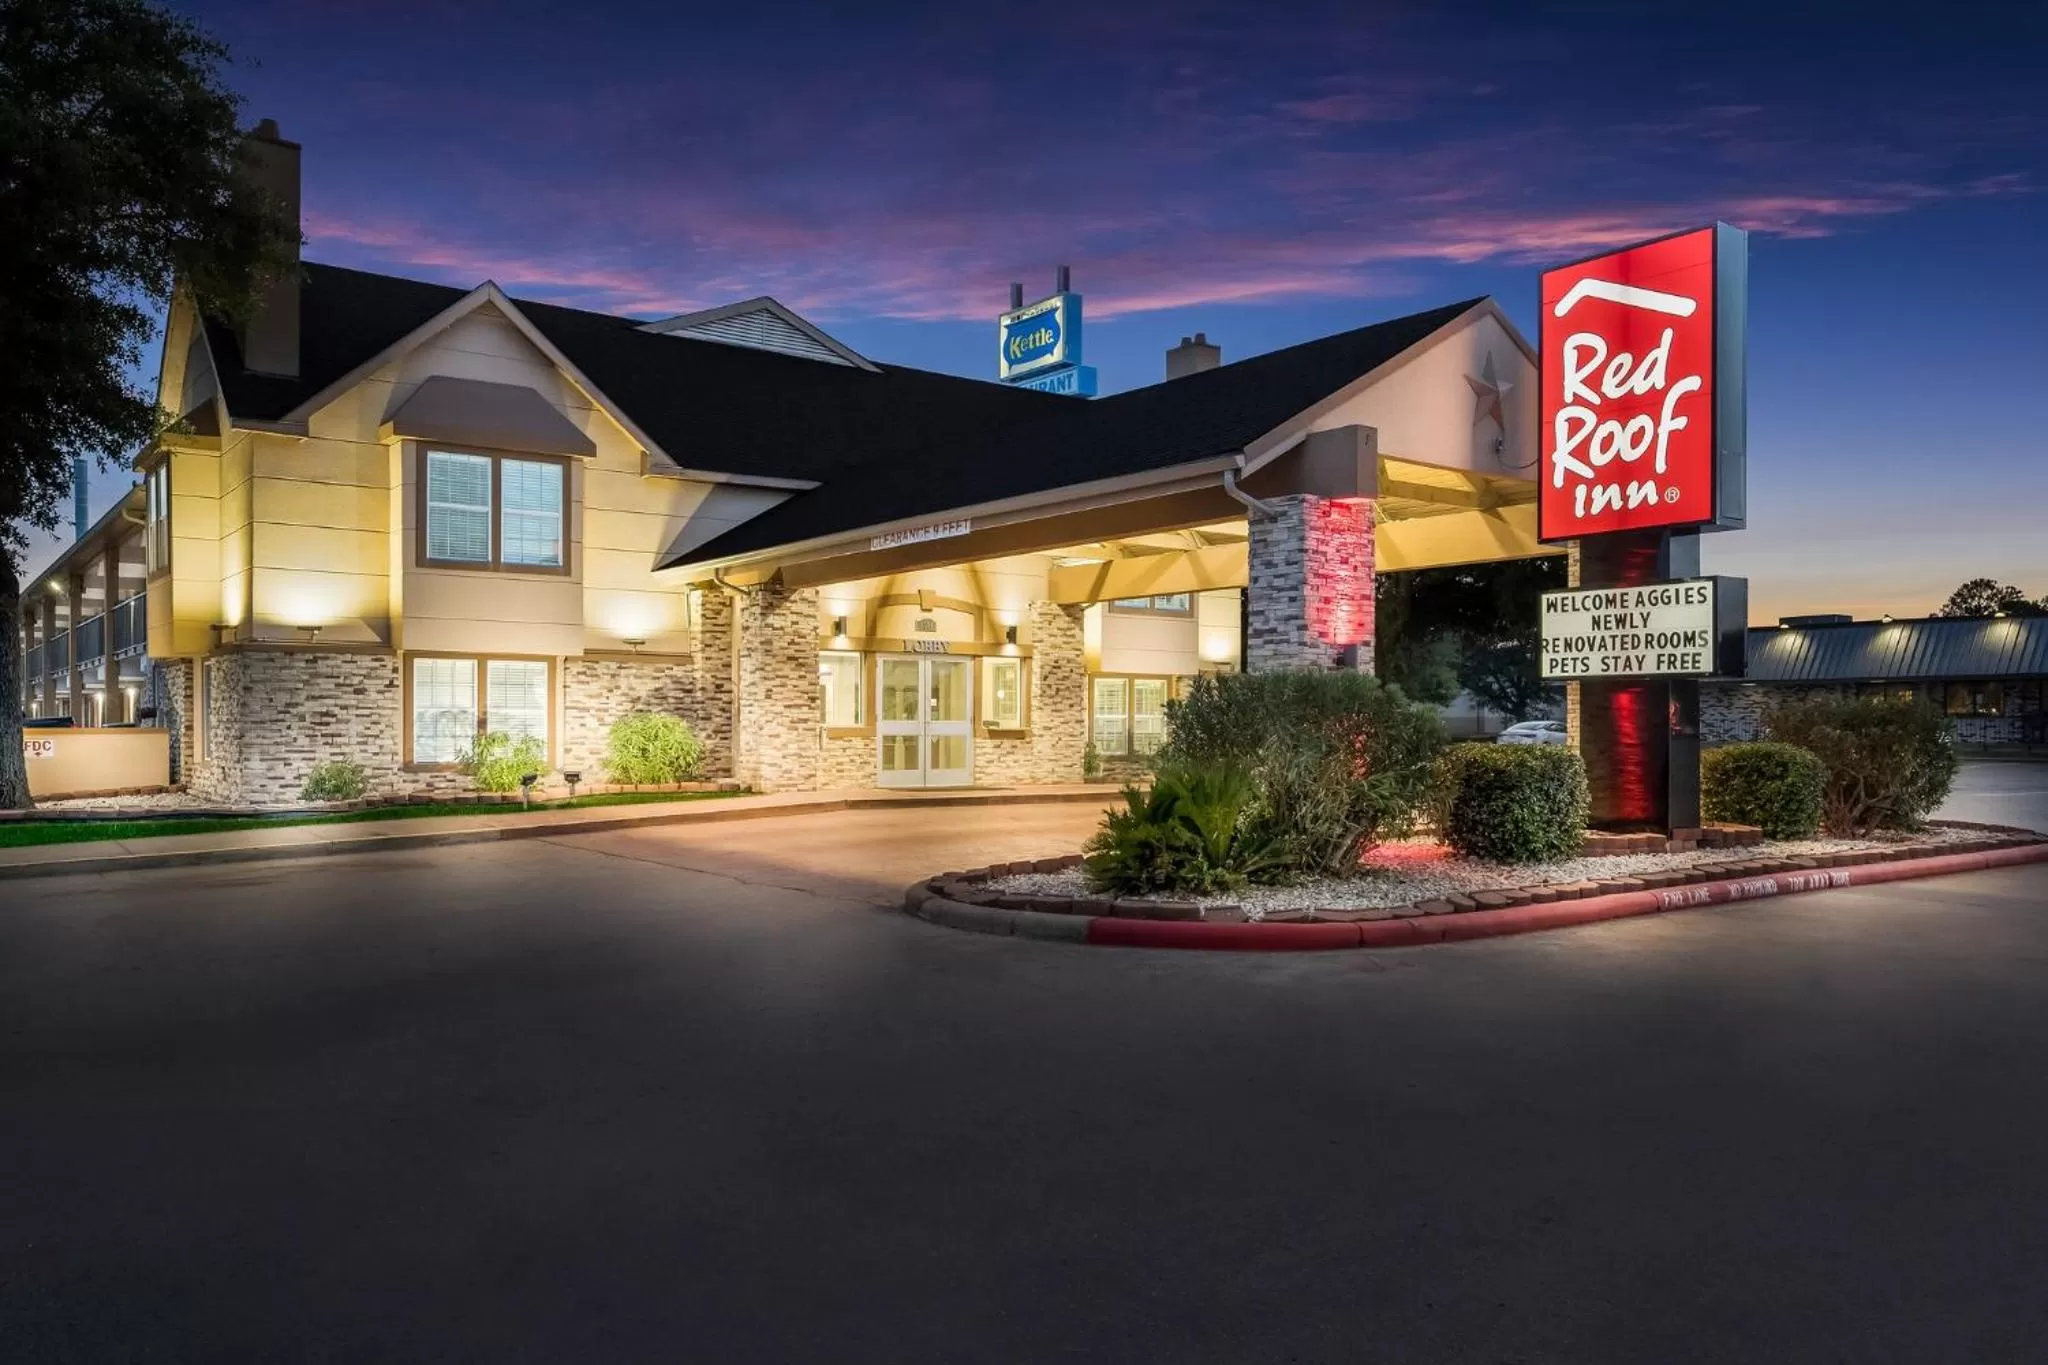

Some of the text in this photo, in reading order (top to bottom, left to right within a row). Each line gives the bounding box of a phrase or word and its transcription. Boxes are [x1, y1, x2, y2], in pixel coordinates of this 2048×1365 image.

[1010, 327, 1055, 360] Kettle
[1563, 327, 1674, 405] Red
[1552, 375, 1702, 488] Roof
[872, 525, 930, 548] CLEARANCE
[943, 518, 969, 535] FEET
[1546, 586, 1708, 613] WELCOME AGGIES
[1592, 611, 1651, 631] NEWLY
[903, 639, 951, 655] LOBBY
[1542, 629, 1709, 654] RENOVATED ROOMS
[1550, 652, 1702, 674] PETS STAY FREE
[24, 740, 52, 752] FDC
